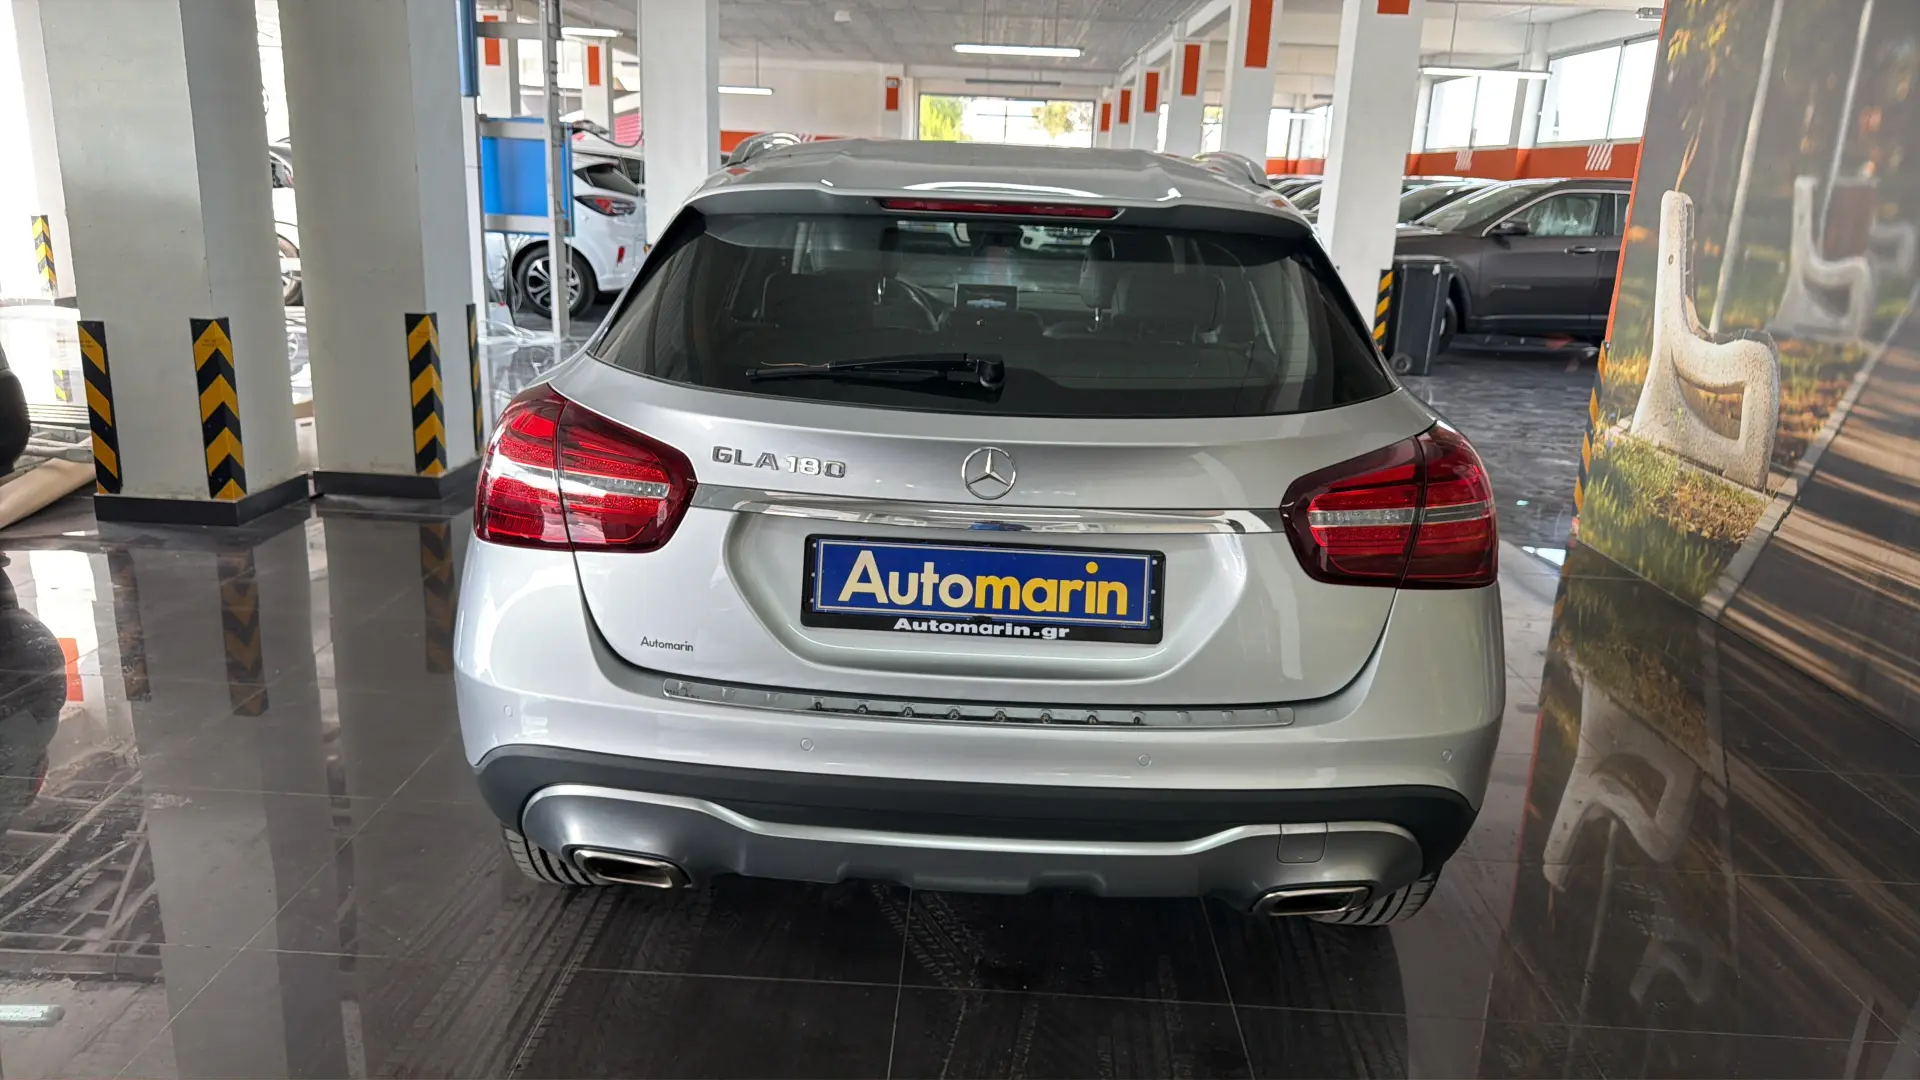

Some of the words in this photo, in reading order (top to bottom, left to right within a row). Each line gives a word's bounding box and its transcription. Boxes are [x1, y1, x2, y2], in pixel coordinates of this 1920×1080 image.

[712, 445, 779, 471] GLA
[786, 455, 846, 478] 180
[838, 550, 1128, 615] Automarin
[893, 617, 1070, 640] Automarin.gr
[640, 636, 694, 652] Automarin
